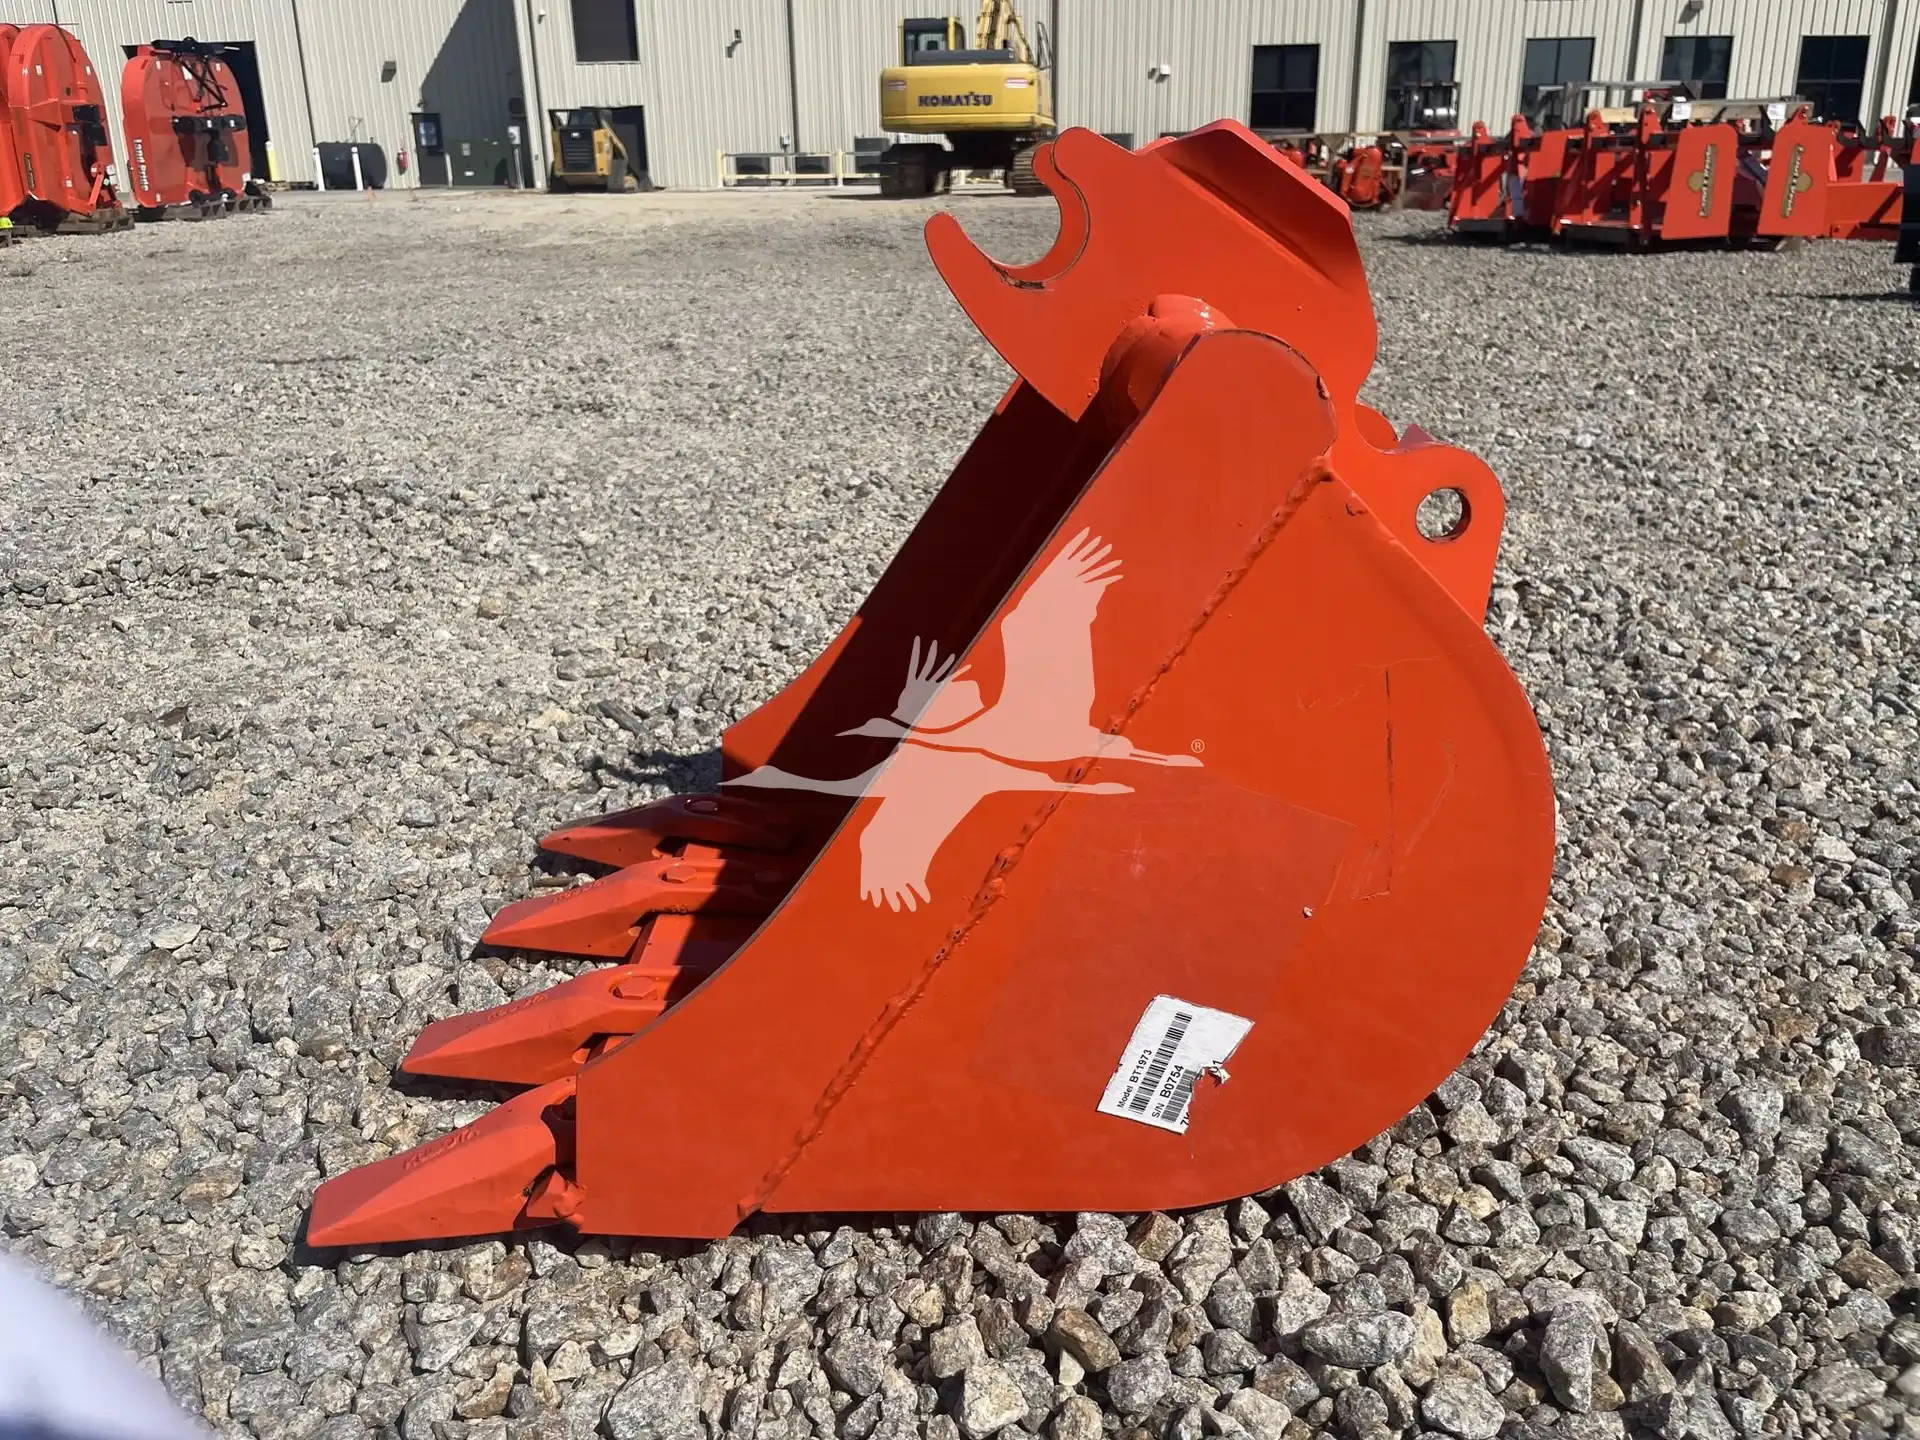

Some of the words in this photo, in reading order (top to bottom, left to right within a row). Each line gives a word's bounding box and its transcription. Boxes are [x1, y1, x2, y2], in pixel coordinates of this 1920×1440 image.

[918, 91, 993, 107] KOMATSU
[1117, 1085, 1134, 1109] Model
[1129, 1049, 1153, 1084] BT1973
[1151, 1103, 1165, 1118] S/N
[1160, 1064, 1184, 1099] B0754
